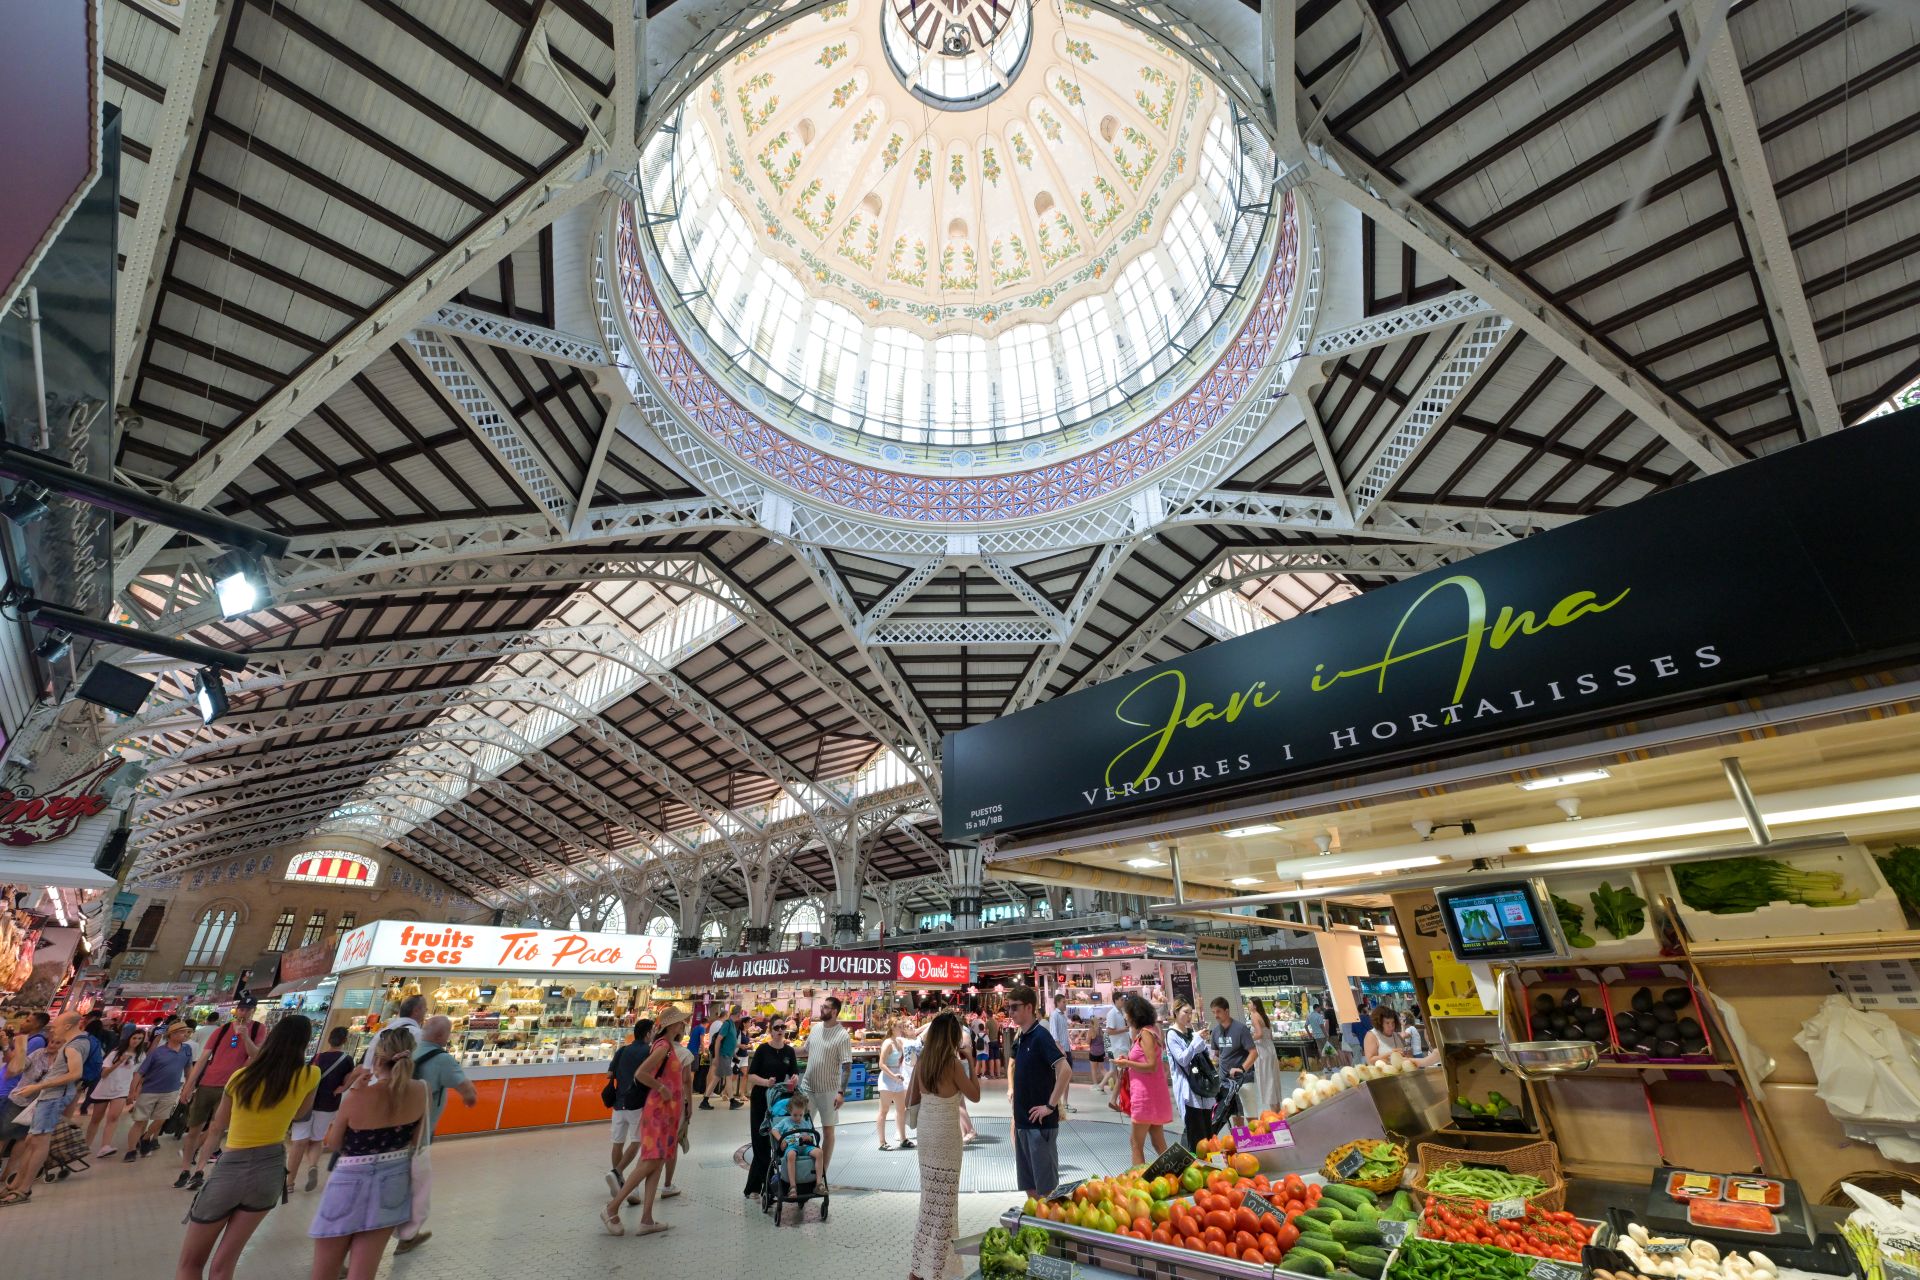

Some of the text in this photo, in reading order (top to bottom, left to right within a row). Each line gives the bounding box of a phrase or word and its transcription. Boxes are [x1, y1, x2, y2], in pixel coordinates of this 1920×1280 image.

[1105, 669, 1281, 797] Javi
[1340, 575, 1631, 725] Ana
[1082, 645, 1722, 805] VERDURES I HORTALISSES
[970, 804, 1002, 818] PUESTOS
[965, 821, 973, 830] 15
[978, 815, 1003, 827] 18/18B
[400, 925, 474, 948] fruits
[403, 949, 462, 965] secs
[497, 931, 624, 967] Tio Paco
[742, 957, 790, 976] PUCHADES
[820, 955, 891, 975] PUCHADES
[918, 957, 948, 979] David
[1278, 956, 1309, 967] andreu
[1257, 972, 1288, 982] natura
